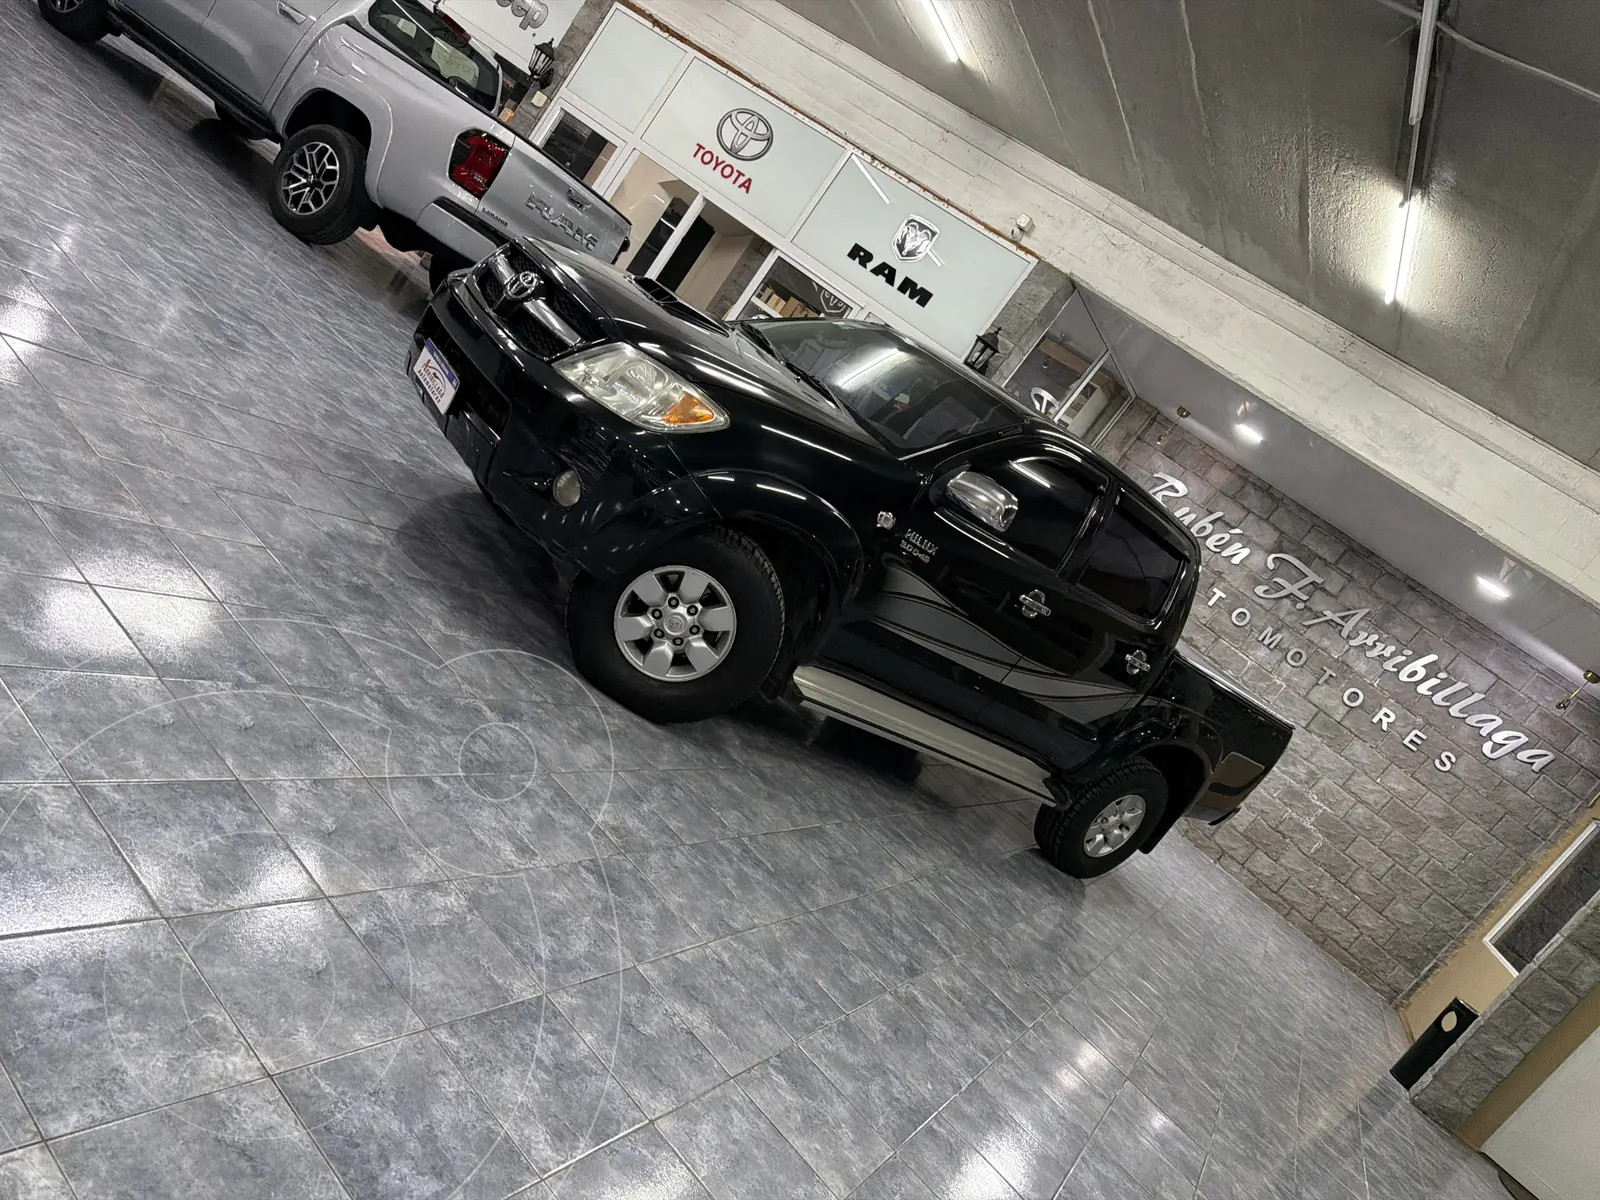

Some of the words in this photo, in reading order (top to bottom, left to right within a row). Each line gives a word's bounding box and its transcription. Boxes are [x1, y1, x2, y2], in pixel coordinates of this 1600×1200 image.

[496, 0, 549, 31] ep
[692, 143, 753, 194] TOYOTA
[847, 242, 933, 308] RAM
[1150, 472, 1251, 565] Rubén
[1254, 553, 1325, 610] F.
[1303, 608, 1555, 773] Arribillaga
